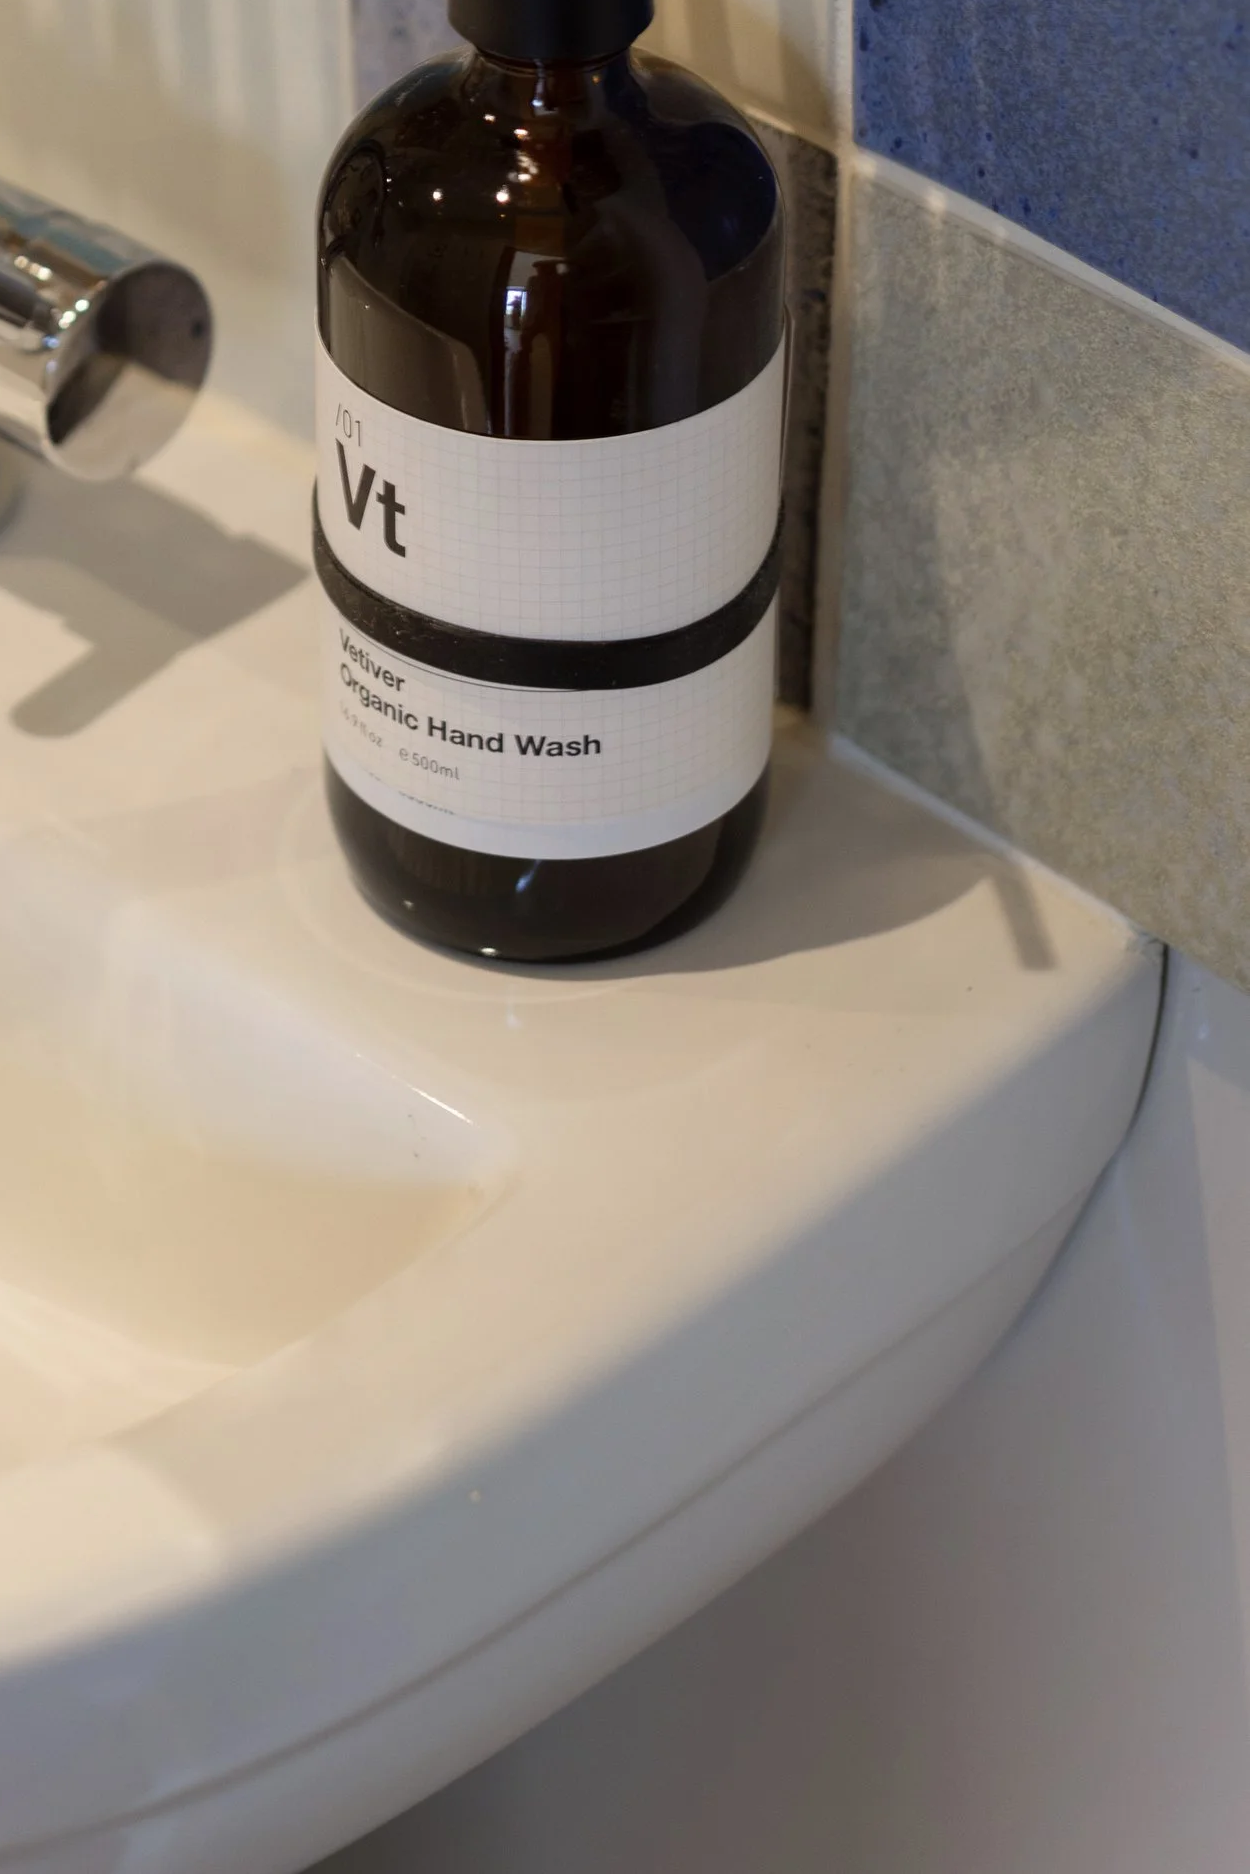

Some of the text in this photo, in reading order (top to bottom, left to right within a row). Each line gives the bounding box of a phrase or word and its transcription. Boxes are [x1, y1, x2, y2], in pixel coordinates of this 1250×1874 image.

[336, 403, 361, 447] /01
[335, 438, 406, 558] Vt
[339, 627, 405, 692] Vetiver
[340, 662, 602, 757] Organic Hand Wash
